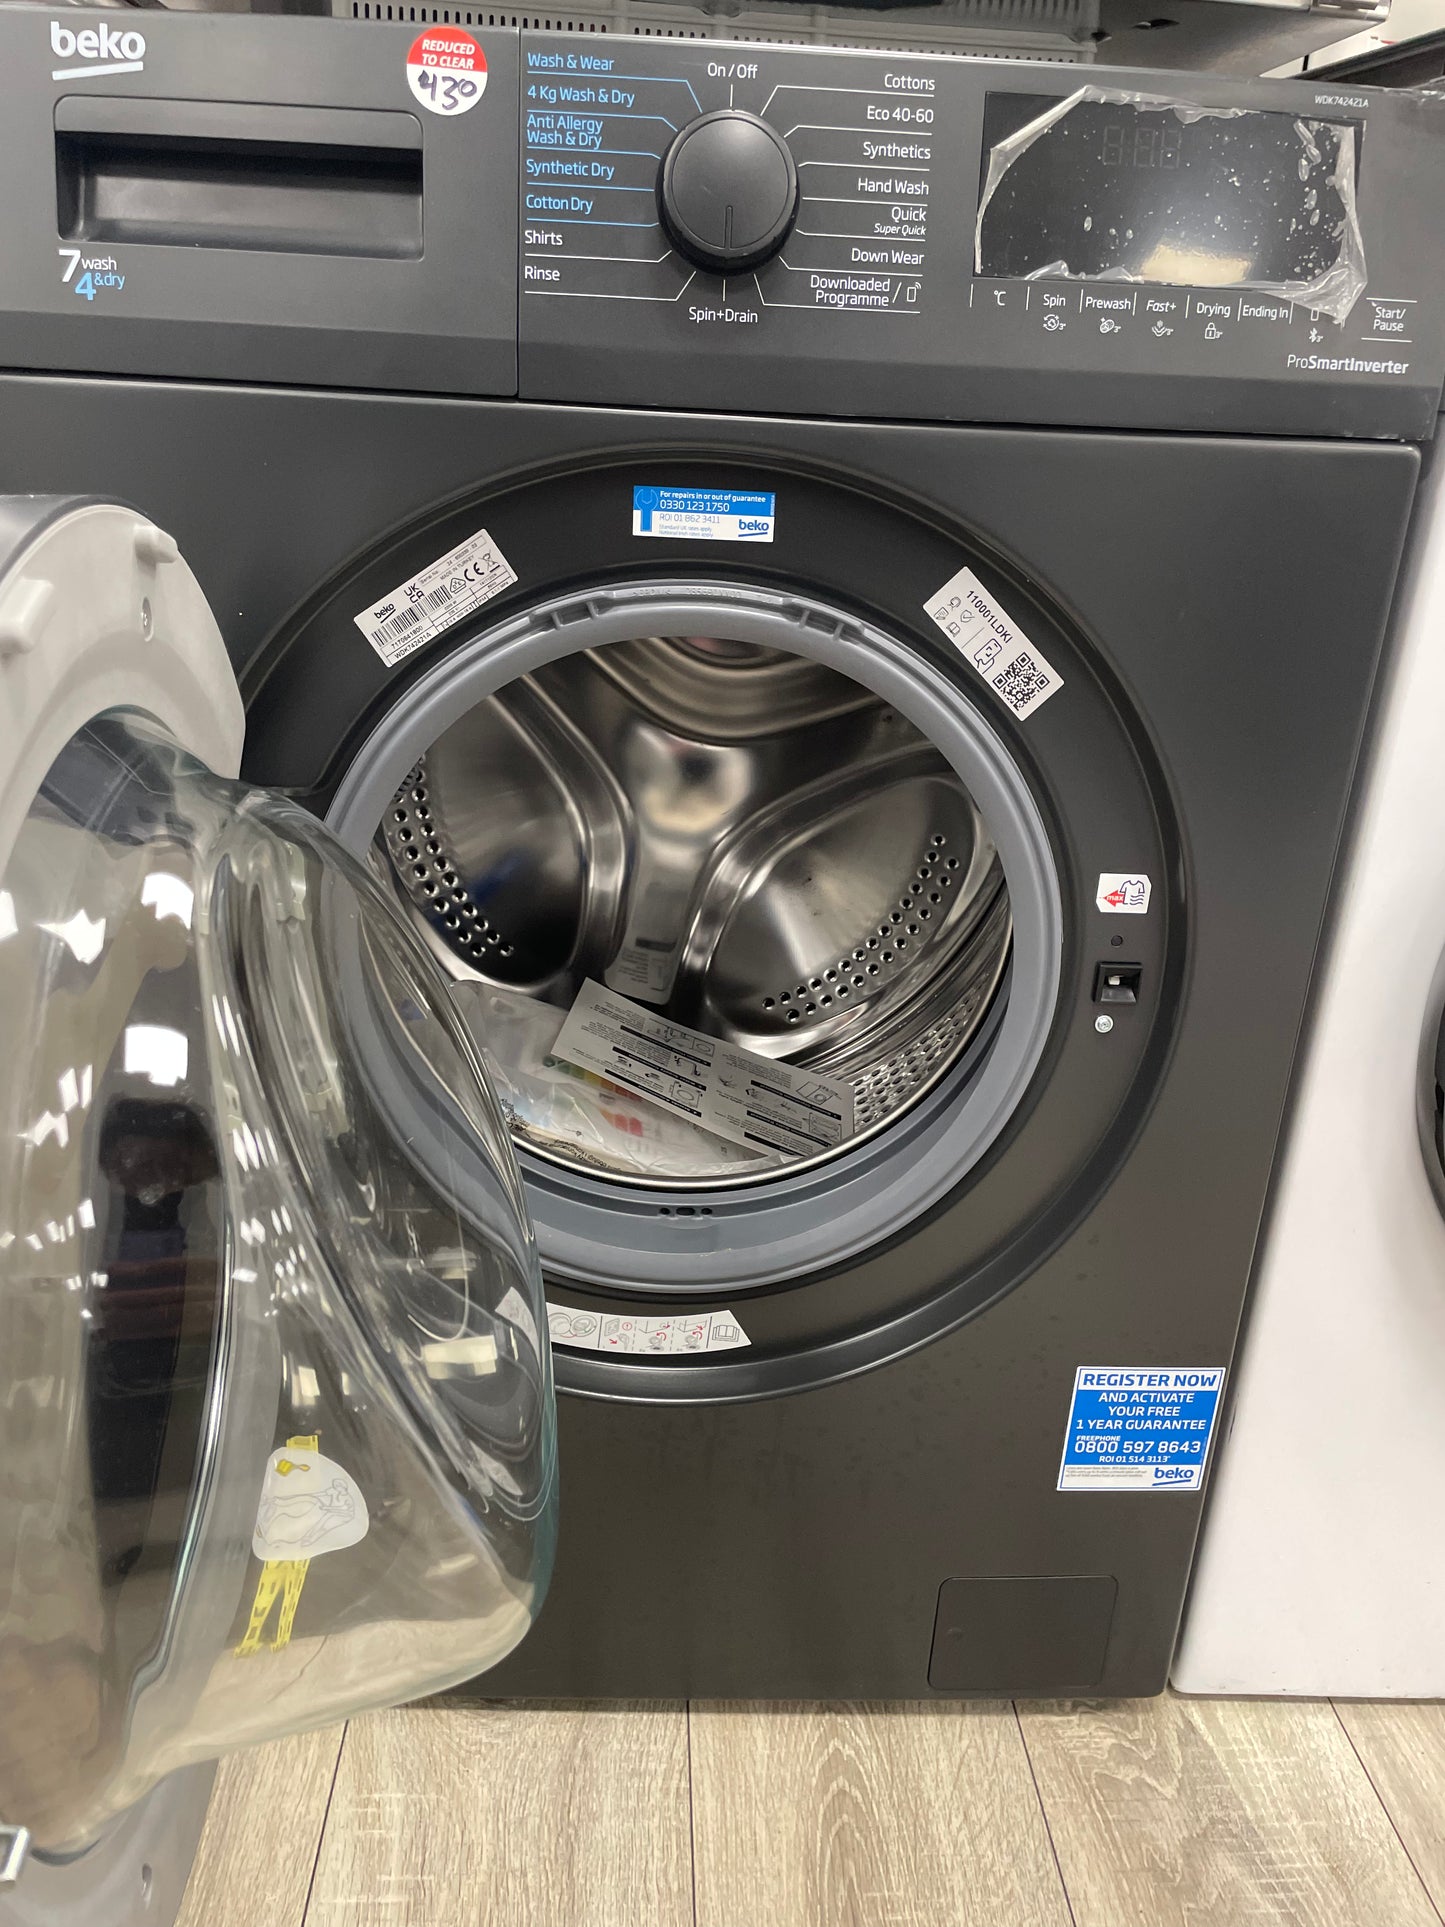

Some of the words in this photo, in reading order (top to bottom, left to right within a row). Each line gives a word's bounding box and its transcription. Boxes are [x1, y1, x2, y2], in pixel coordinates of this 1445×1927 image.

[51, 21, 146, 59] beko
[422, 39, 476, 55] REDUCED
[422, 53, 438, 66] TO
[439, 56, 474, 70] CLEAR
[527, 52, 564, 68] Wash
[566, 54, 577, 69] &
[580, 55, 615, 71] Wear
[707, 62, 726, 77] On
[736, 64, 758, 79] Off
[884, 73, 936, 91] Cottons
[527, 85, 537, 99] 4
[540, 85, 557, 103] Kg
[560, 87, 595, 102] Wash
[598, 88, 609, 103] &
[611, 89, 635, 108] Dry
[1314, 94, 1369, 108] WDK742421A
[866, 105, 890, 121] Eco
[892, 107, 934, 124] 40-60
[527, 114, 555, 129] Anti
[556, 115, 603, 135] Allergy
[527, 129, 563, 144] Wash
[565, 131, 576, 146] &
[578, 132, 603, 150] Dry
[863, 141, 931, 160] Synthetics
[526, 158, 589, 177] Synthetic
[591, 162, 615, 181] Dry
[857, 177, 892, 194] Hand
[894, 179, 929, 195] Wash
[526, 194, 569, 211] Cotton
[571, 197, 593, 215] Dry
[891, 206, 927, 223] Quick
[524, 229, 563, 246] Shirts
[873, 223, 901, 236] Super
[901, 224, 926, 236] Quick
[851, 248, 889, 264] Down
[891, 249, 925, 265] Wear
[59, 249, 81, 283] 7
[81, 255, 117, 271] wash
[524, 265, 561, 281] Rinse
[75, 272, 97, 301] 4
[810, 274, 891, 292] Downloaded
[815, 289, 890, 308] Programme
[1042, 293, 1066, 309] Spin
[1085, 296, 1132, 311] Prewash
[1145, 299, 1177, 313] Fast+
[688, 306, 758, 324] Spin+Drain
[1196, 302, 1231, 318] Drying
[1242, 304, 1278, 321] Ending
[1278, 306, 1289, 319] In
[1375, 306, 1407, 320] Start/
[1373, 319, 1404, 332] Pause
[1287, 354, 1409, 374] ProSmartInverter
[659, 490, 671, 498] For
[672, 491, 695, 500] repairs
[732, 495, 766, 503] guarantee
[659, 500, 684, 510] 0330
[686, 500, 704, 511] 123
[706, 502, 730, 512] 1750
[659, 512, 672, 521] ROI
[674, 513, 683, 522] 01
[684, 514, 701, 523] 862
[702, 515, 720, 524] 3411
[738, 519, 769, 531] beko
[403, 583, 420, 597] UK
[409, 590, 425, 604] CA
[373, 602, 396, 620] beko
[966, 590, 1013, 644] 110001LDKI
[394, 632, 432, 660] WDK742421A
[1106, 894, 1124, 902] max
[1082, 1373, 1170, 1387] REGISTER
[1173, 1374, 1217, 1387] NOW
[1098, 1392, 1128, 1403] AND
[1130, 1392, 1195, 1403] ACTIVATE
[1108, 1406, 1145, 1416] YOUR
[1147, 1406, 1181, 1417] FREE
[1076, 1419, 1084, 1430] 1
[1087, 1419, 1123, 1430] YEAR
[1125, 1419, 1207, 1430] GUARANTEE
[1074, 1441, 1118, 1454] 0800
[1122, 1441, 1154, 1454] 597
[1157, 1441, 1201, 1454] 8643
[1099, 1455, 1115, 1463] ROI
[1115, 1455, 1127, 1463] 01
[1128, 1455, 1144, 1463] 514
[1154, 1467, 1195, 1479] beko
